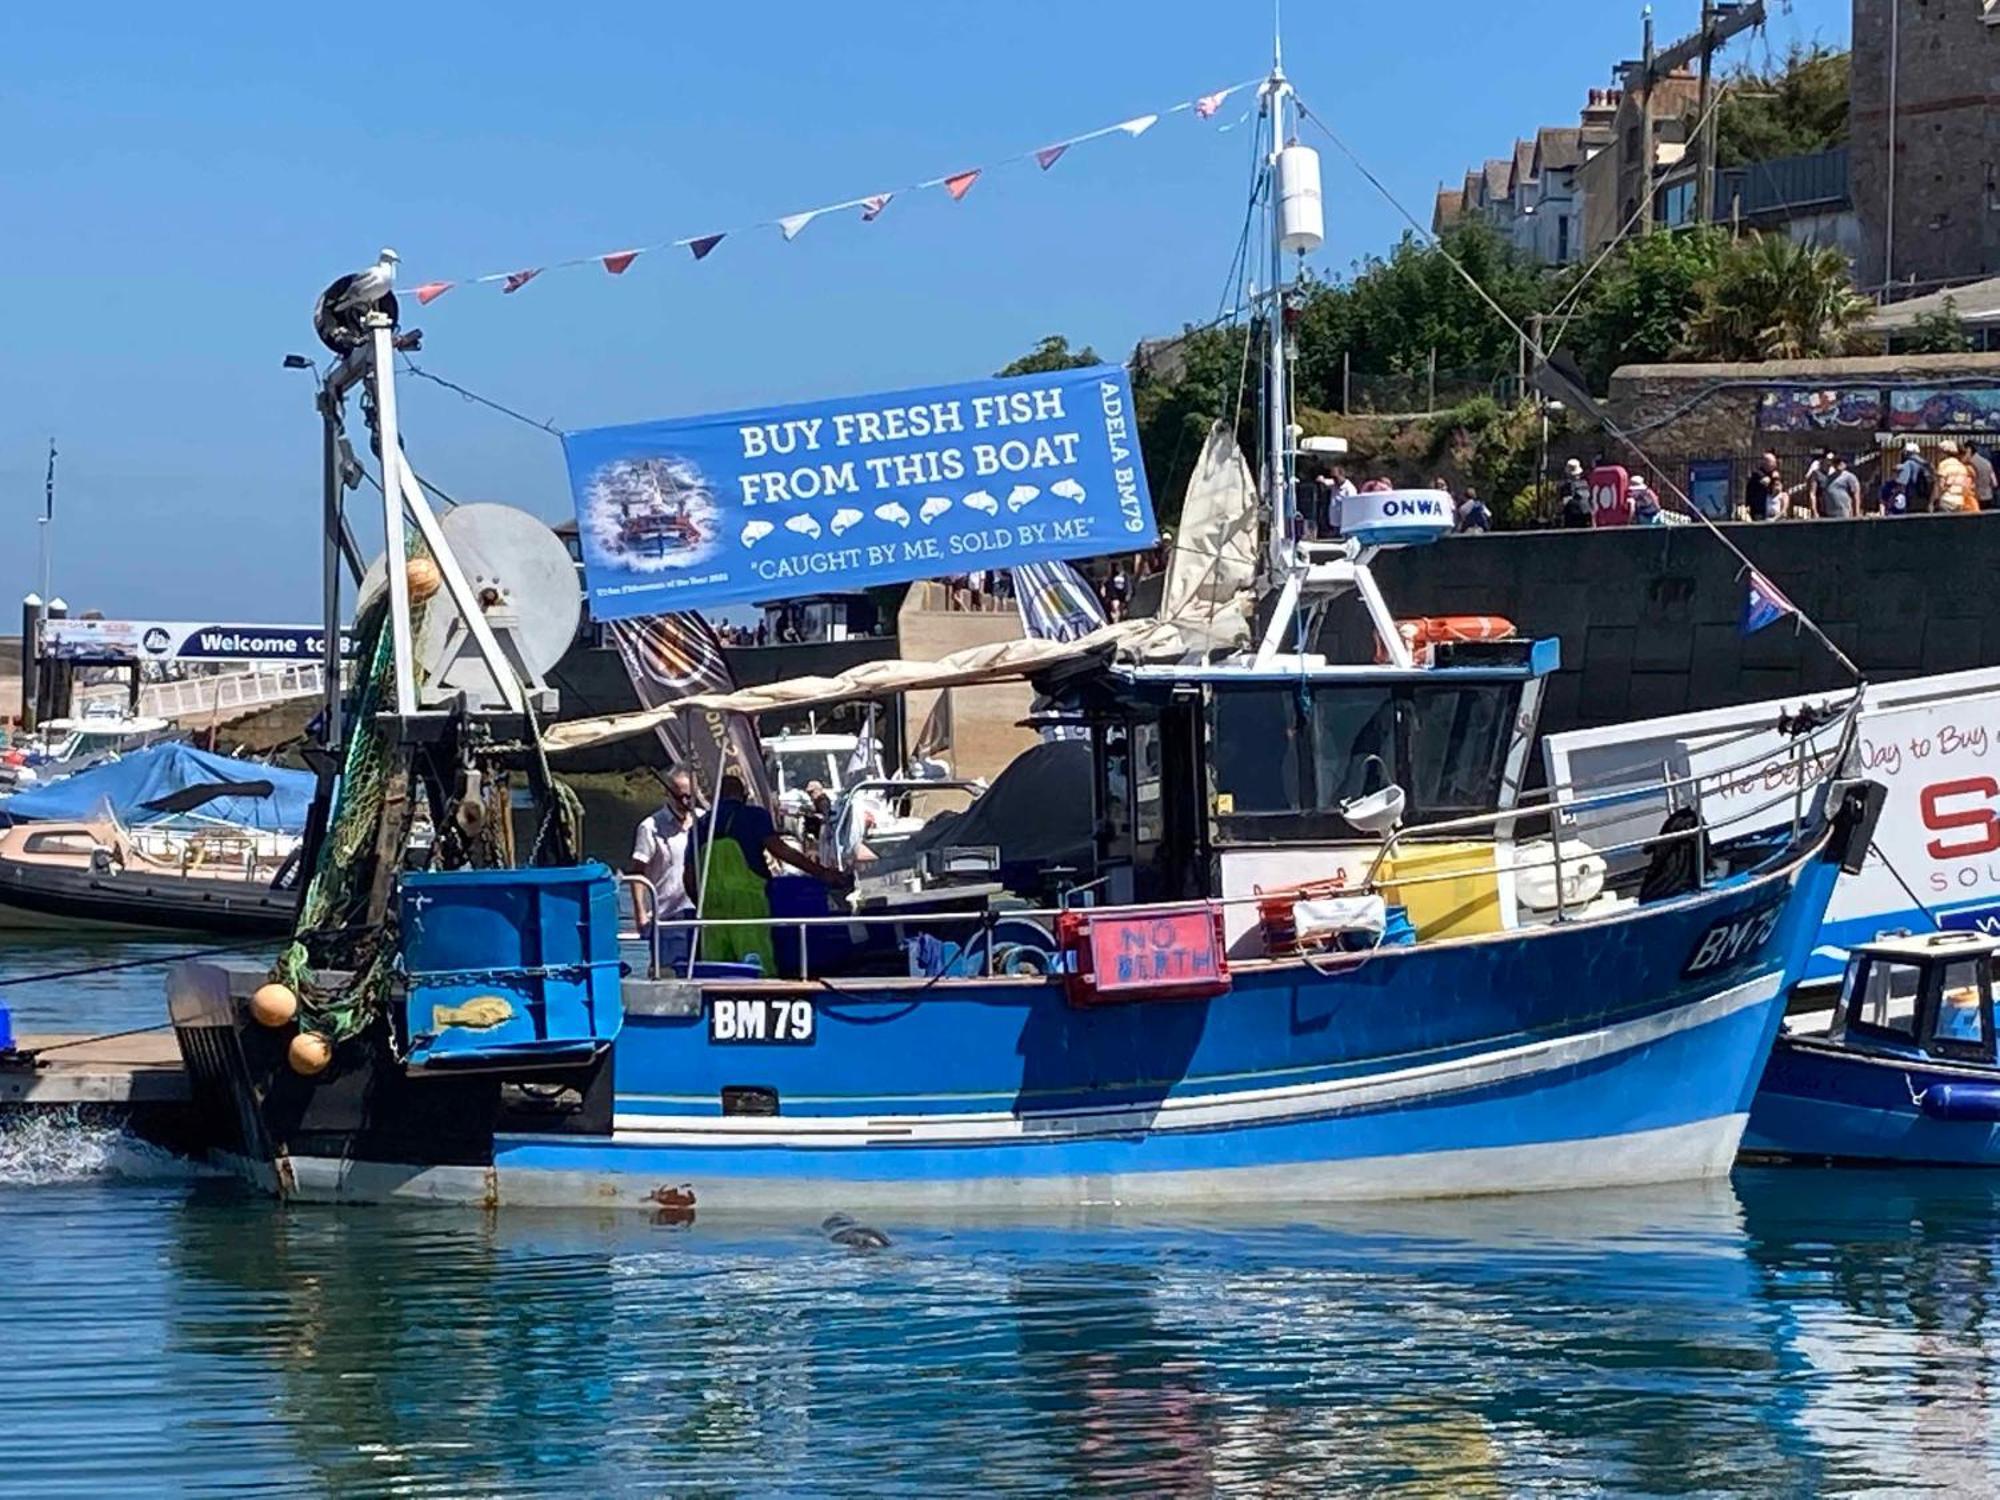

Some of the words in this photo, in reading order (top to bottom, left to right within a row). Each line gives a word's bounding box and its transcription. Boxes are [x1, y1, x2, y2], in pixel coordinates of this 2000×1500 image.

[739, 418, 823, 459] BUY
[832, 402, 965, 447] FRESH
[971, 387, 1066, 429] FISH
[1100, 381, 1130, 464] ADELA
[738, 462, 859, 506] FROM
[865, 449, 965, 489] THIS
[973, 432, 1080, 476] BOAT
[1114, 467, 1145, 533] BM79
[1383, 500, 1443, 517] ONWA
[750, 548, 864, 580] "CAUGHT
[867, 543, 898, 567] BY
[904, 538, 945, 562] ME,
[950, 528, 1013, 556] SOLD
[1017, 523, 1049, 546] BY
[1052, 516, 1096, 541] ME"
[200, 633, 297, 652] Welcome
[305, 637, 326, 652] to
[1909, 737, 1931, 759] to
[1936, 725, 1988, 757] Buy
[1121, 920, 1176, 950] NO
[1687, 917, 1755, 971] BM
[1117, 948, 1211, 981] BERTH
[714, 1000, 766, 1039] BM
[771, 1000, 812, 1039] 79
